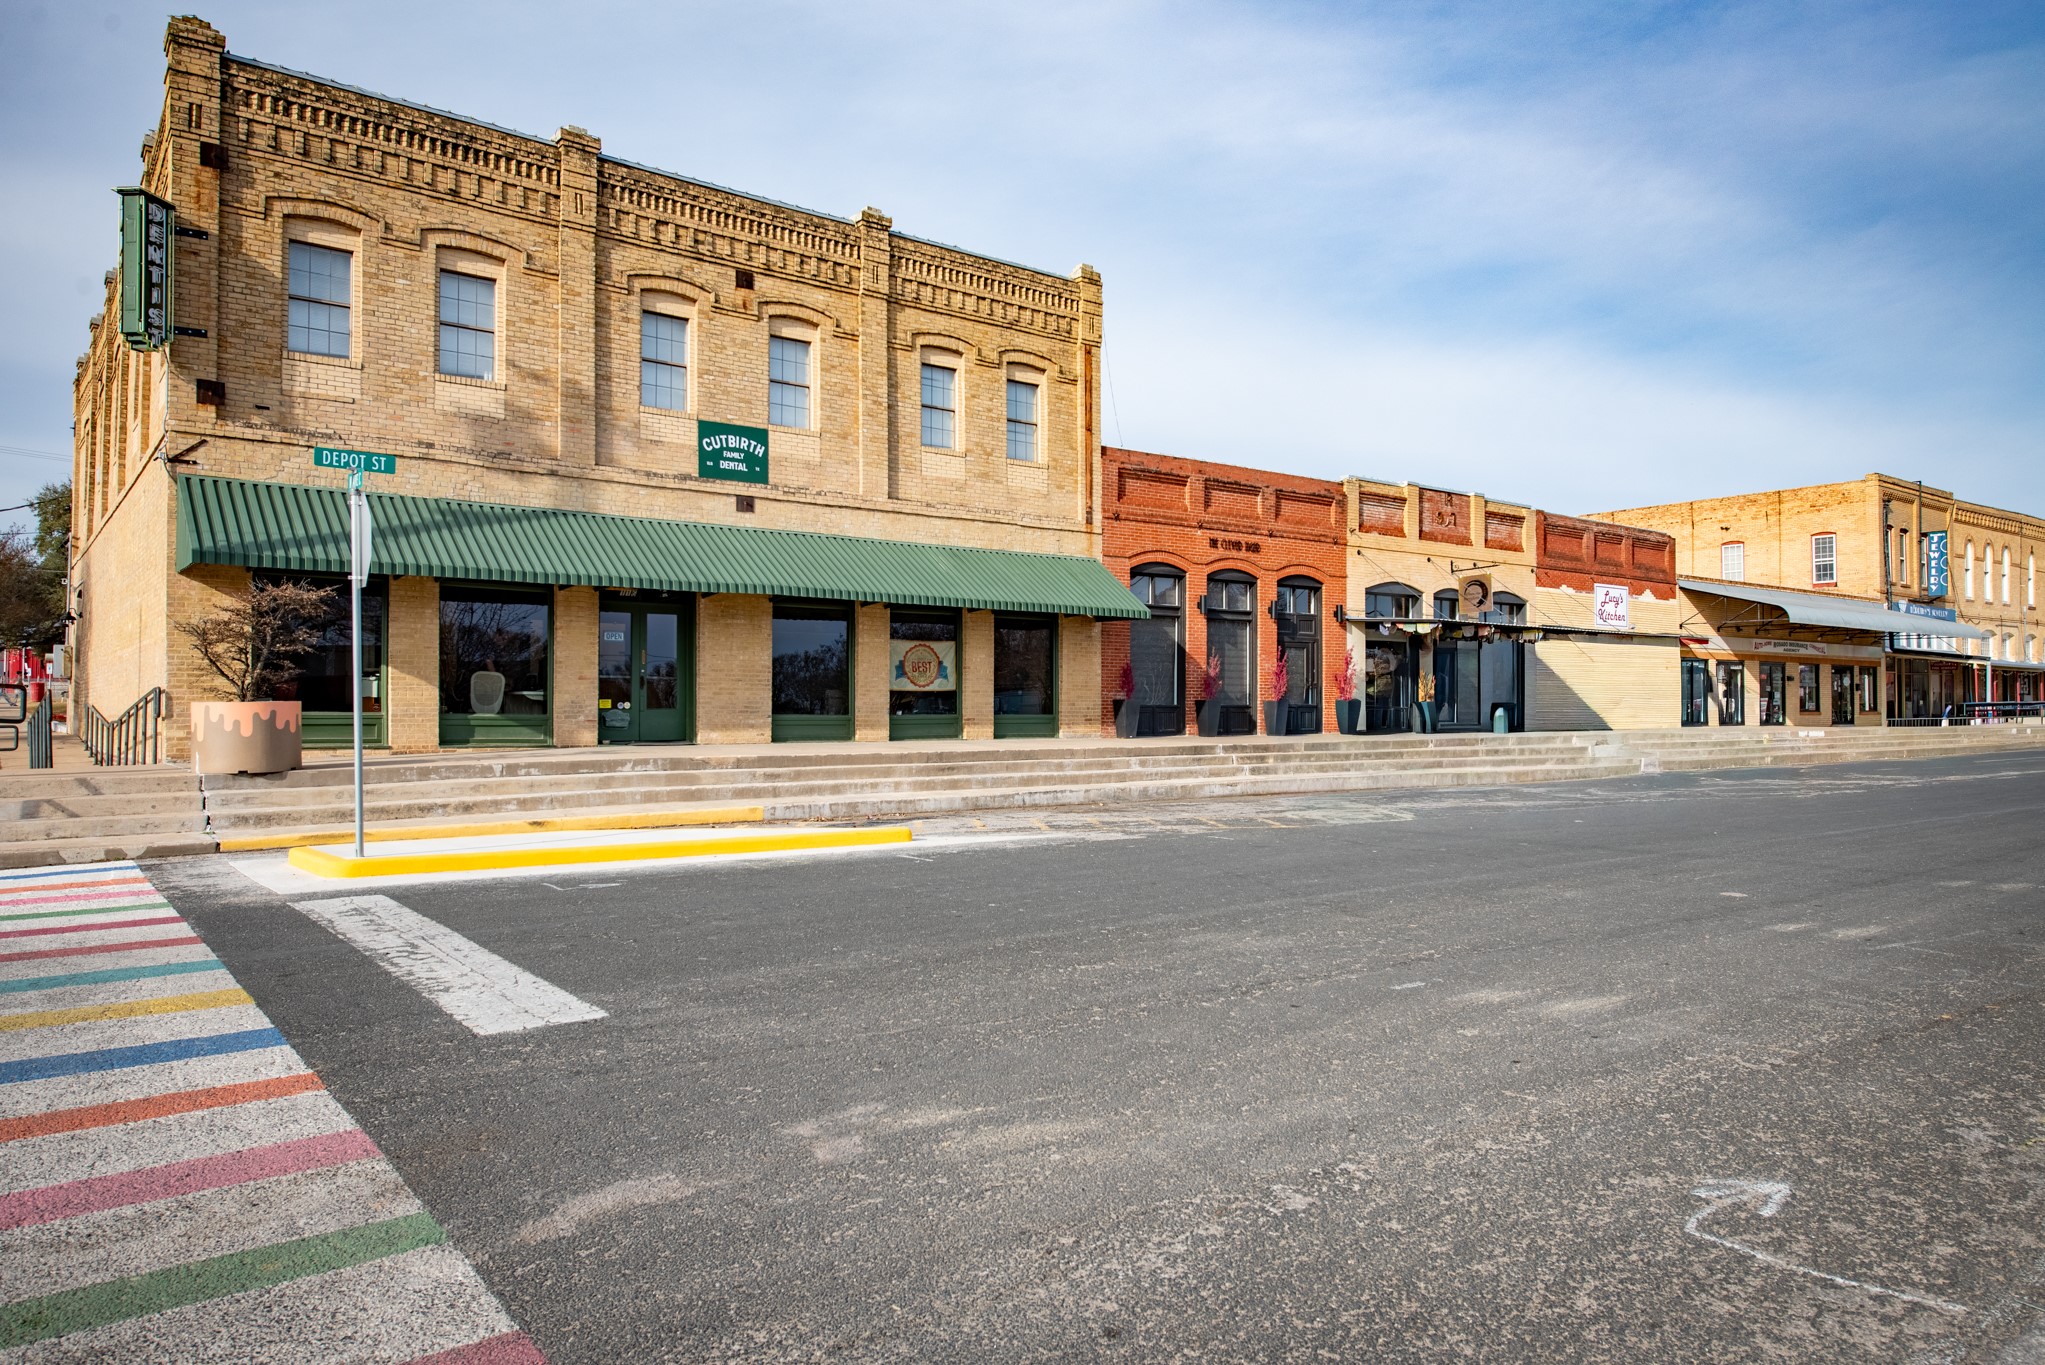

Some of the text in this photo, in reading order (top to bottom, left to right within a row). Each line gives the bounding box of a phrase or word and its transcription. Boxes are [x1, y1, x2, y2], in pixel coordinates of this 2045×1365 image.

[147, 203, 164, 346] DENTIST
[702, 434, 766, 458] CUTBIRTH
[322, 450, 387, 471] DEPOT ST
[723, 450, 745, 460] FAMILY
[719, 460, 749, 472] DENTAL
[1929, 534, 1941, 593] JEWELRY
[1600, 590, 1624, 608] Lucy's
[1597, 608, 1626, 622] Kitchen
[605, 632, 623, 640] OPEN
[911, 661, 932, 673] BEST
